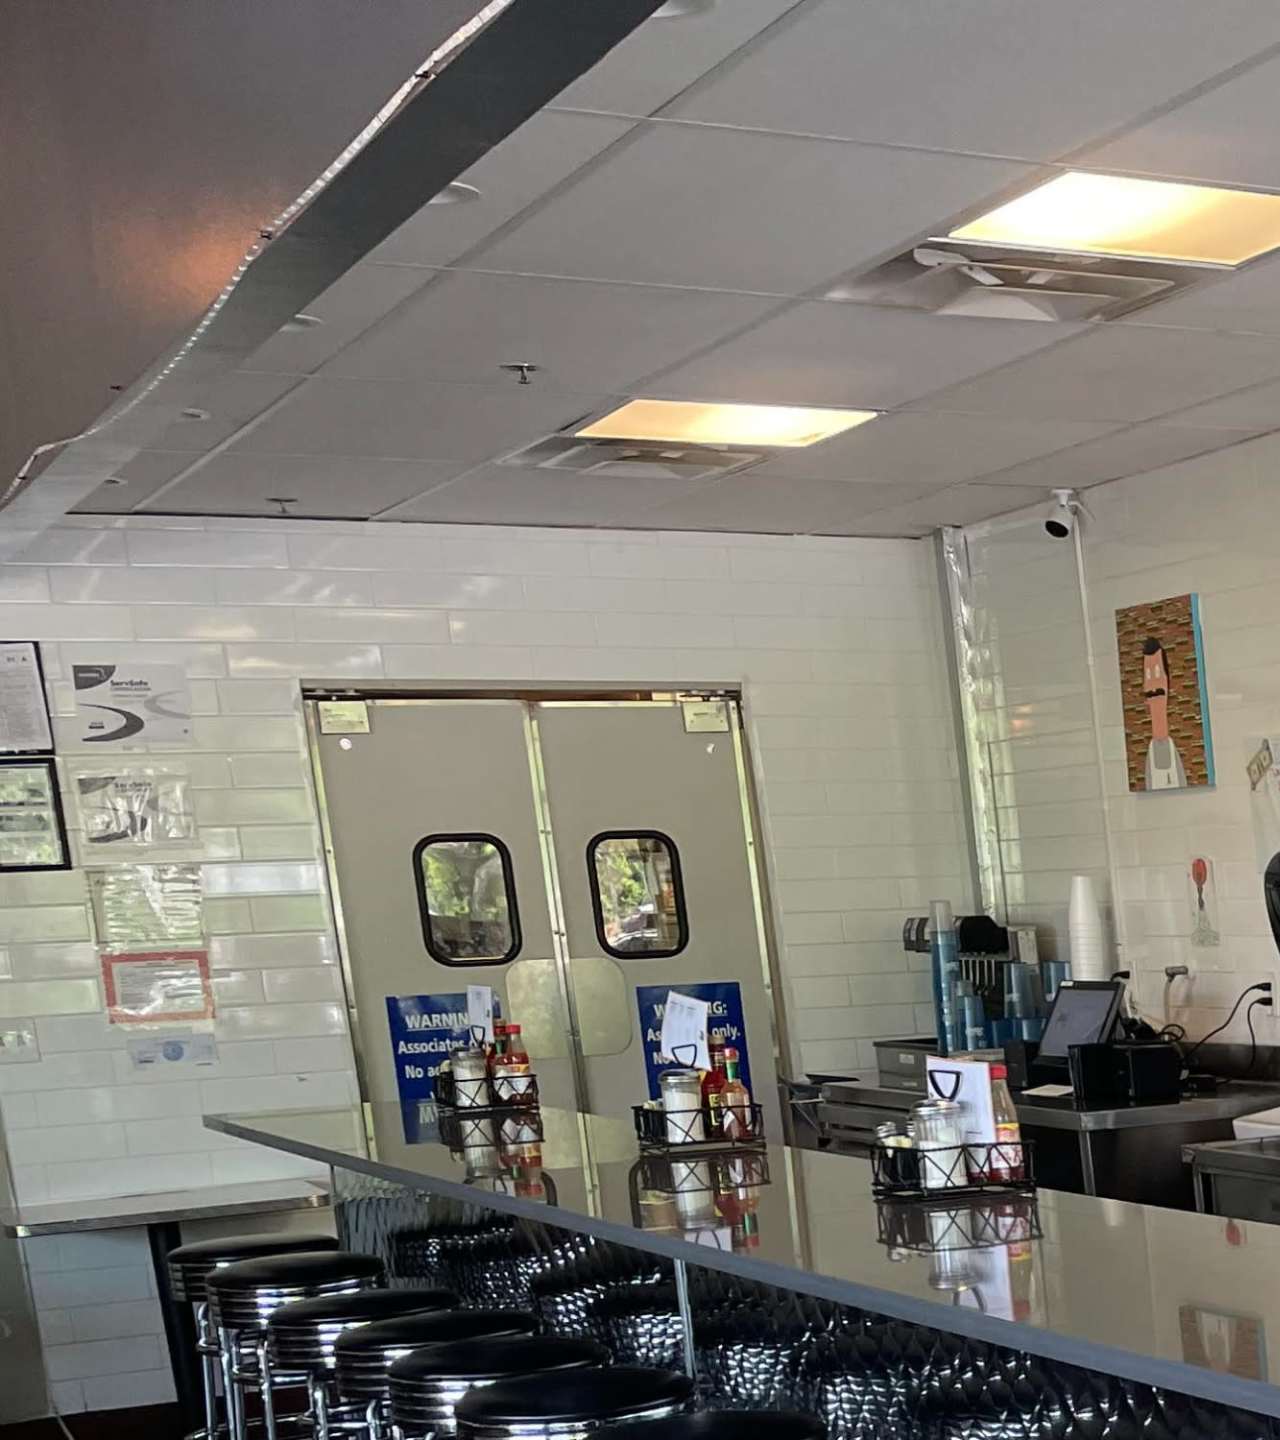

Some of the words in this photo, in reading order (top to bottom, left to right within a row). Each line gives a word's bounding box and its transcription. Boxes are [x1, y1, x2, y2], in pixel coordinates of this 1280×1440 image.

[404, 1011, 470, 1031] WARNIN
[711, 1023, 742, 1041] only.
[404, 1064, 424, 1079] No
